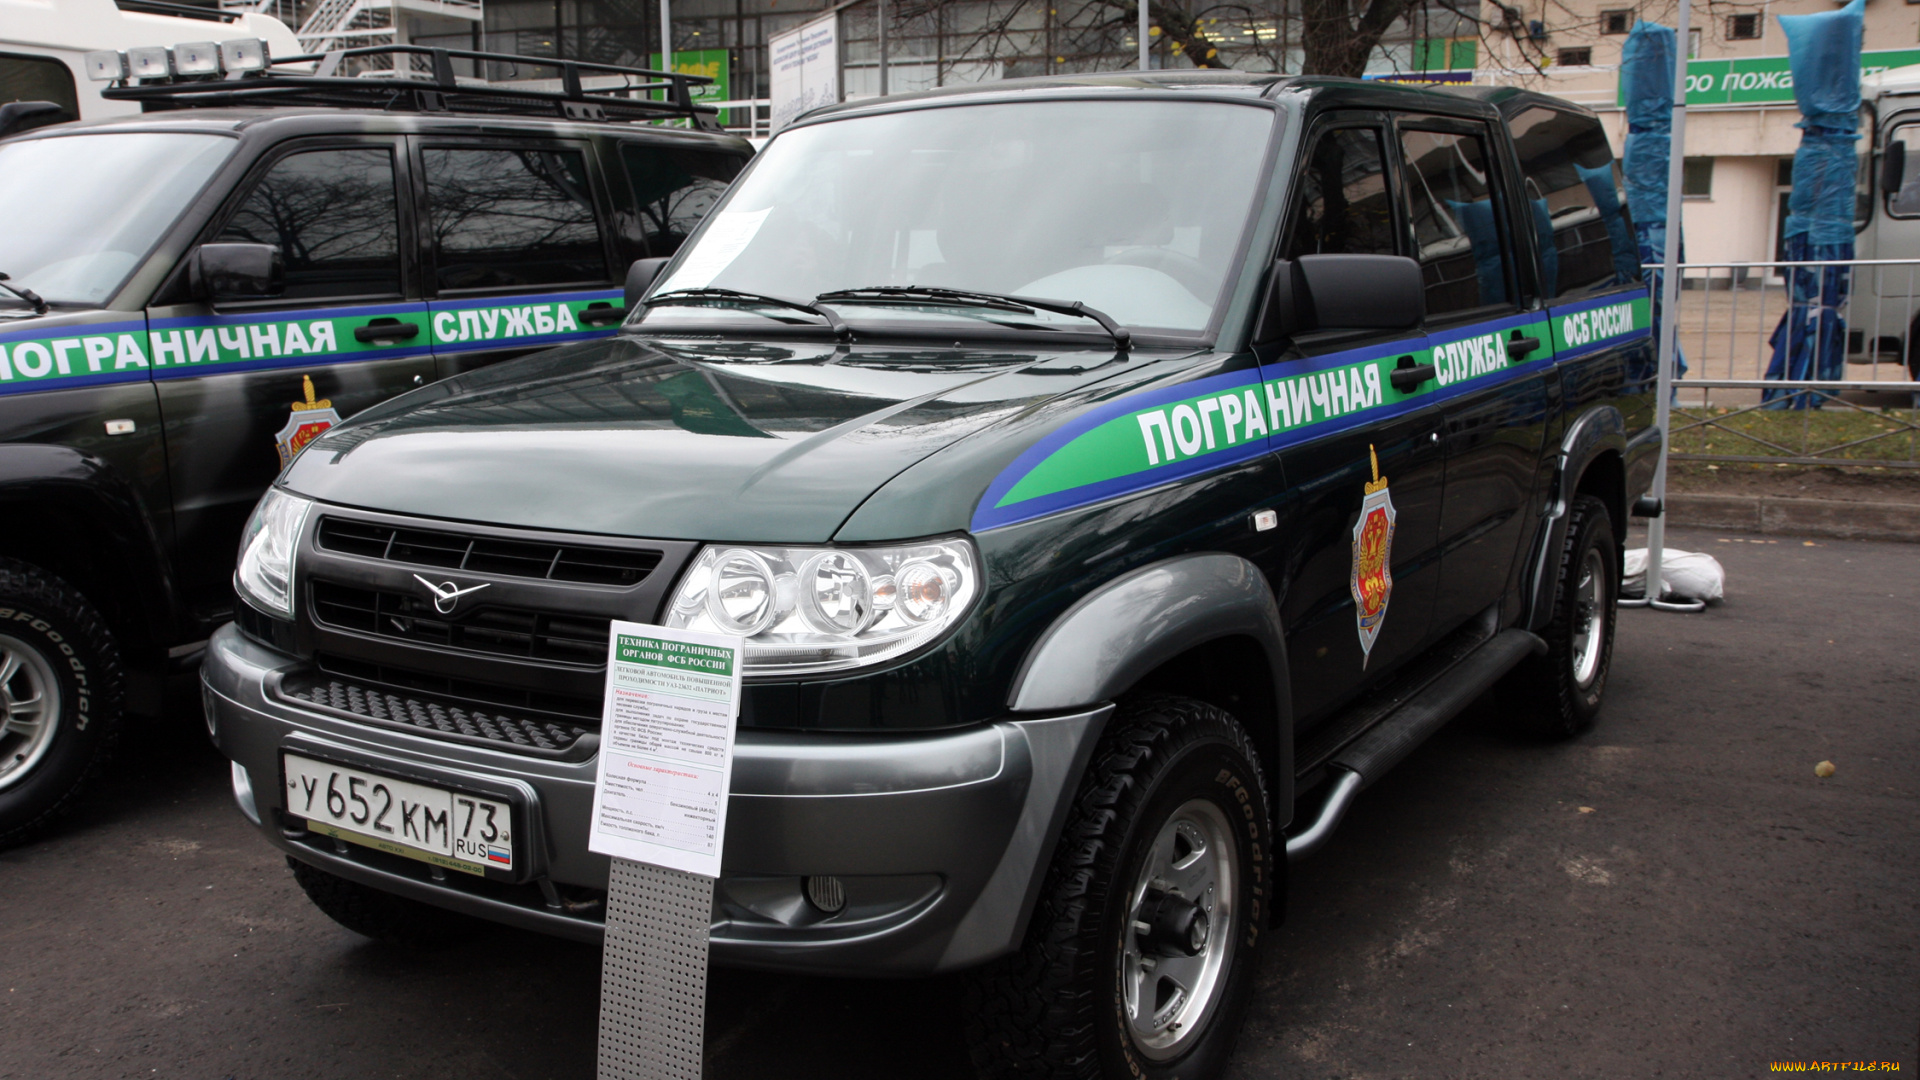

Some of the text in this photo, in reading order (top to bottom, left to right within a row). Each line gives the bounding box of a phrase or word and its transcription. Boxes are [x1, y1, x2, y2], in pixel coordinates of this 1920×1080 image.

[1721, 70, 1793, 91] пожа
[433, 303, 577, 343] СЛУЖБА
[1136, 303, 1633, 466] ПОГРАНИЧНАЯ СЛУЖБА ФСБ РОССИИ
[619, 636, 732, 659] ТЕХНИКА ПОГРАНИЧНЫХ
[622, 649, 726, 670] ОРГАНОВ ФСБ РОССИИ
[616, 665, 731, 688] ЛЕГКОВОЙ АВТОМОБИЛЬ ПОВЫШЕННОЙ
[618, 675, 665, 687] ПРОХОДИМОСТИ
[692, 685, 727, 696] «ПАТРИОТ»
[458, 798, 499, 844] 73
[456, 839, 487, 858] RUS
